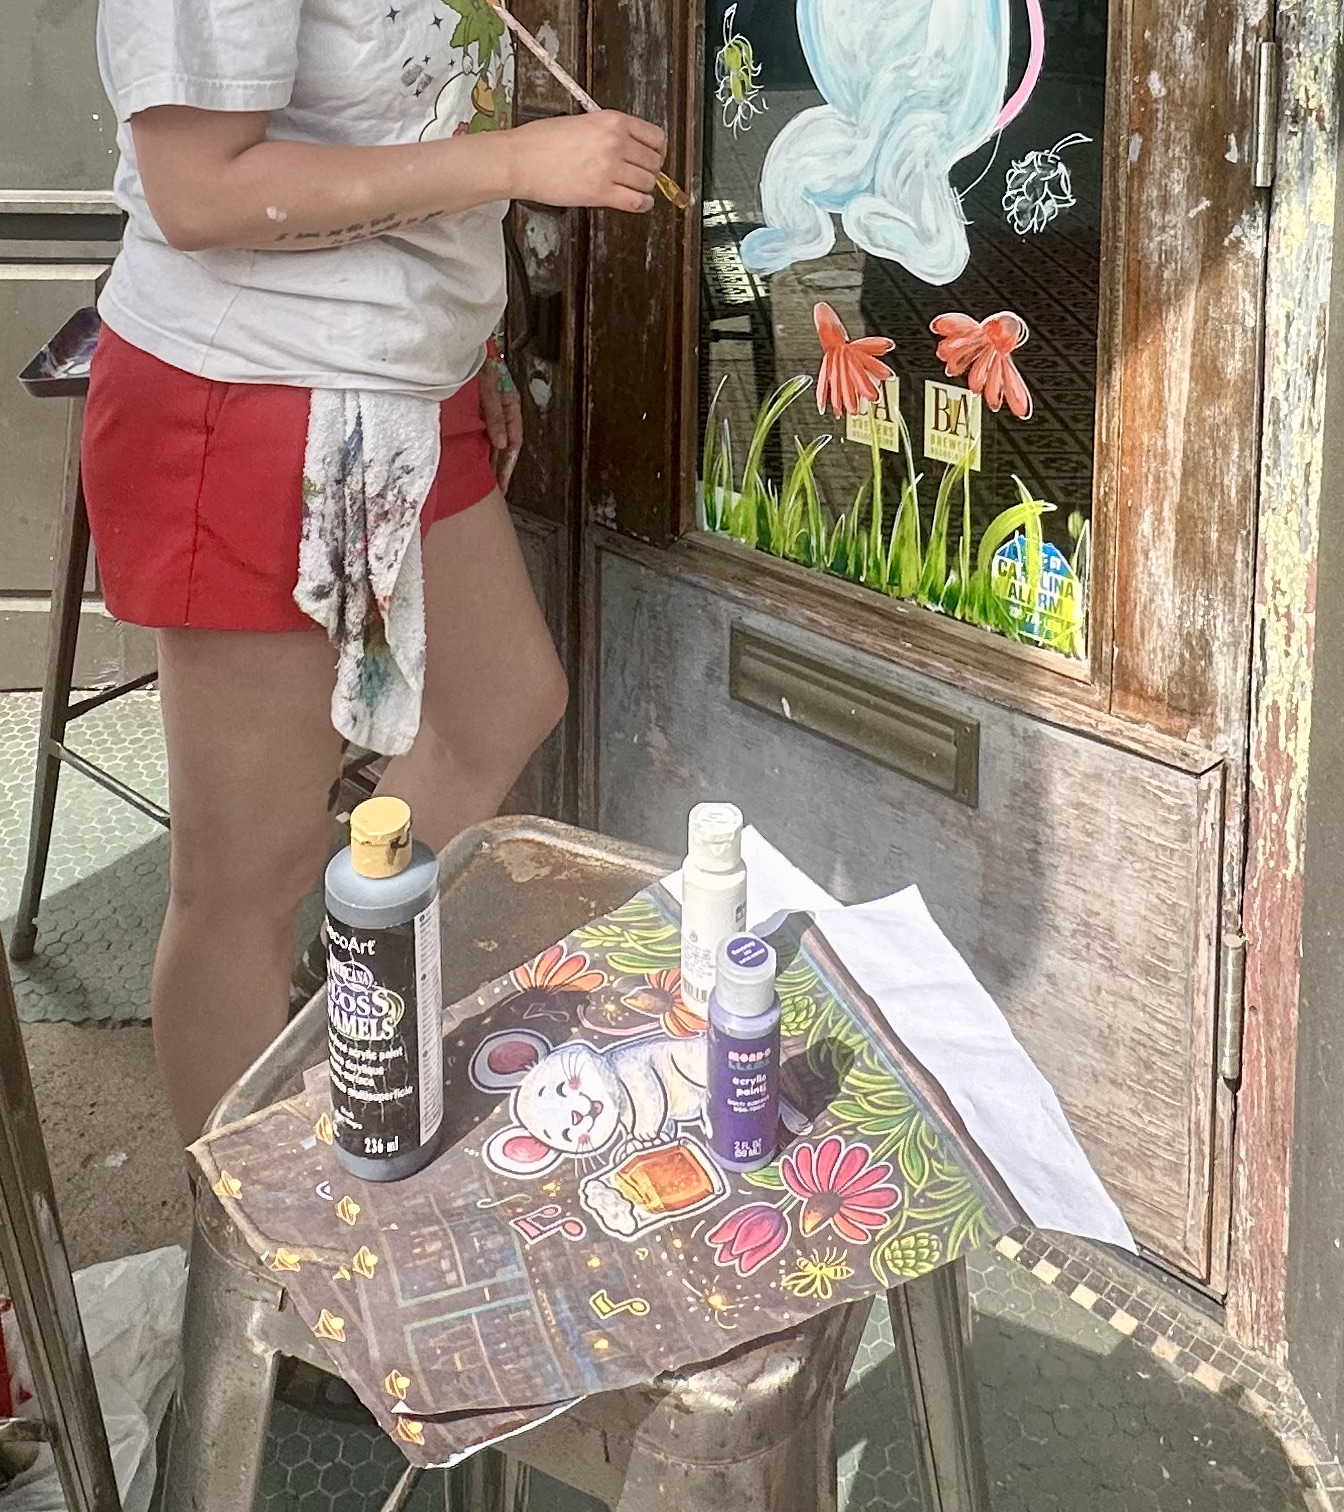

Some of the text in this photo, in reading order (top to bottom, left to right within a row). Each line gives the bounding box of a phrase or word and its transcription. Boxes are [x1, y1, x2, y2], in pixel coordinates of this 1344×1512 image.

[932, 386, 975, 440] BA
[998, 559, 1074, 600] CALINA
[327, 924, 376, 956] ecoArt
[364, 1135, 399, 1154] 236 ml
[734, 1141, 740, 1150] 2
